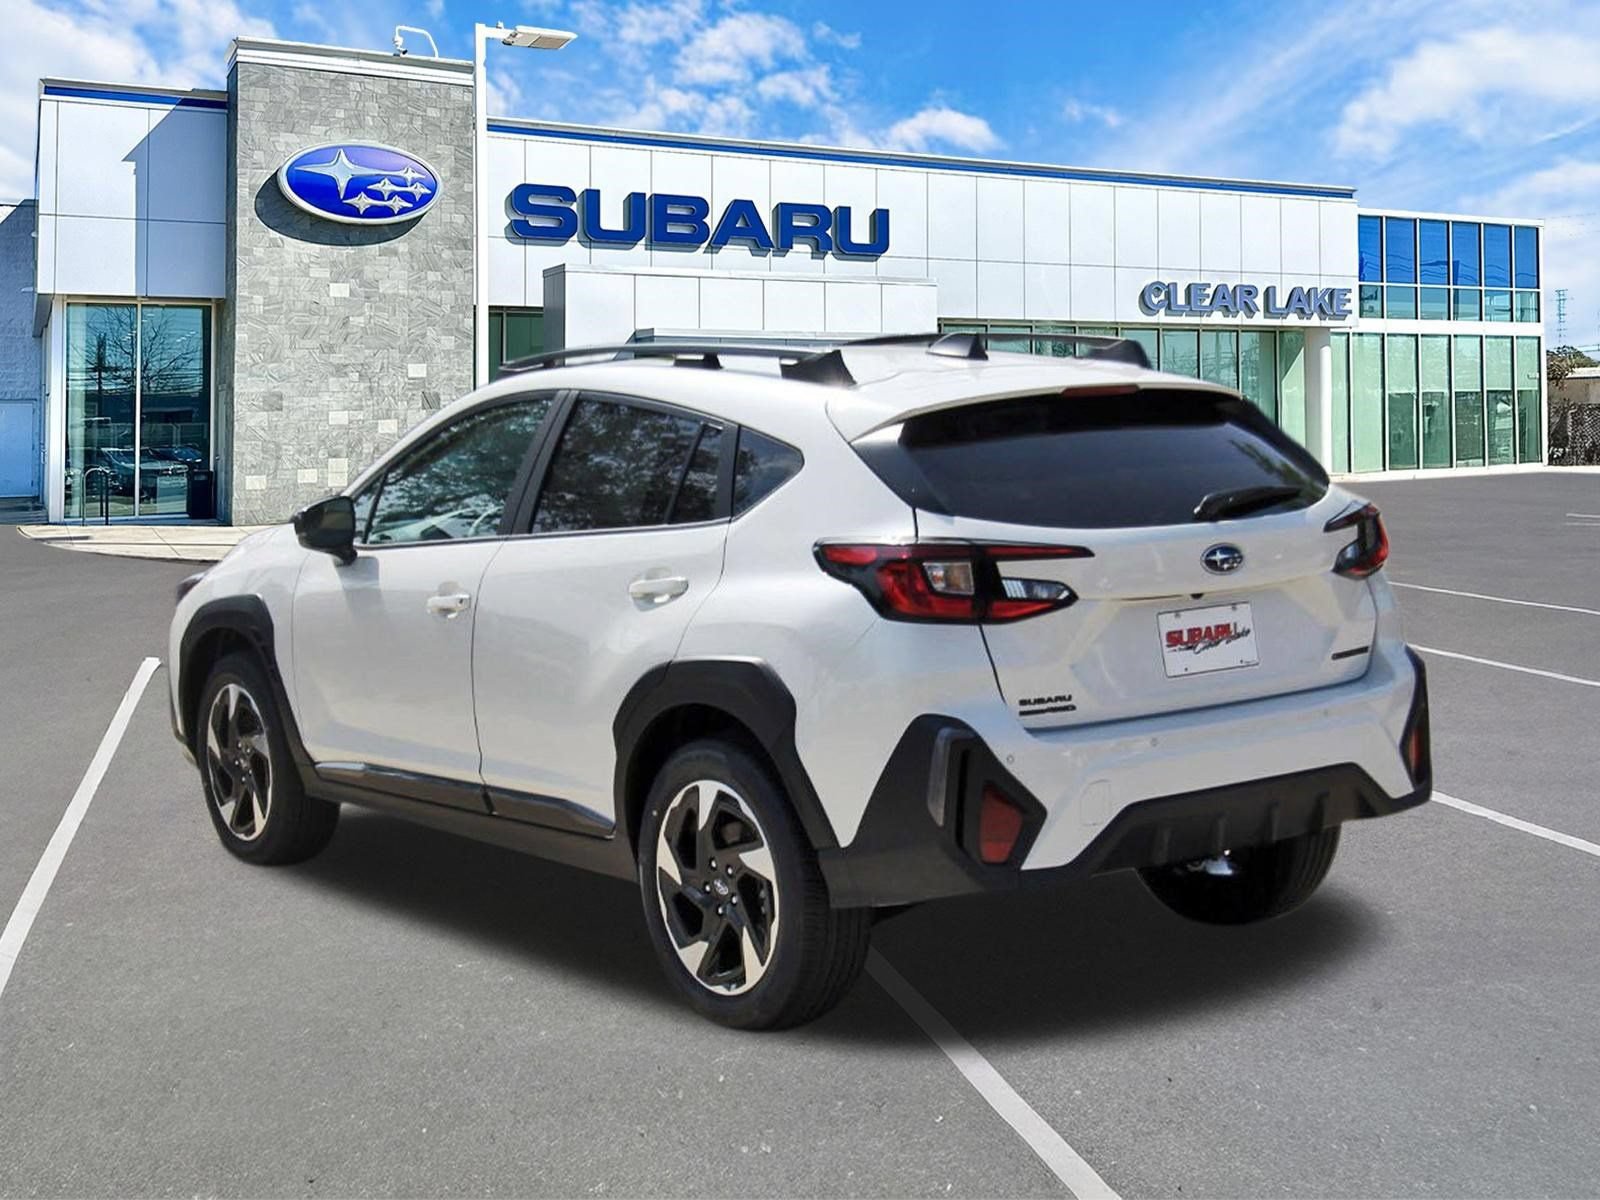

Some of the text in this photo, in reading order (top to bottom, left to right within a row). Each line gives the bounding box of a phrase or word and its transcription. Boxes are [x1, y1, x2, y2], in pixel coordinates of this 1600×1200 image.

[505, 183, 890, 261] SUBARU
[1140, 280, 1352, 320] CLEAR LAKE
[1019, 694, 1072, 706] SUBARU
